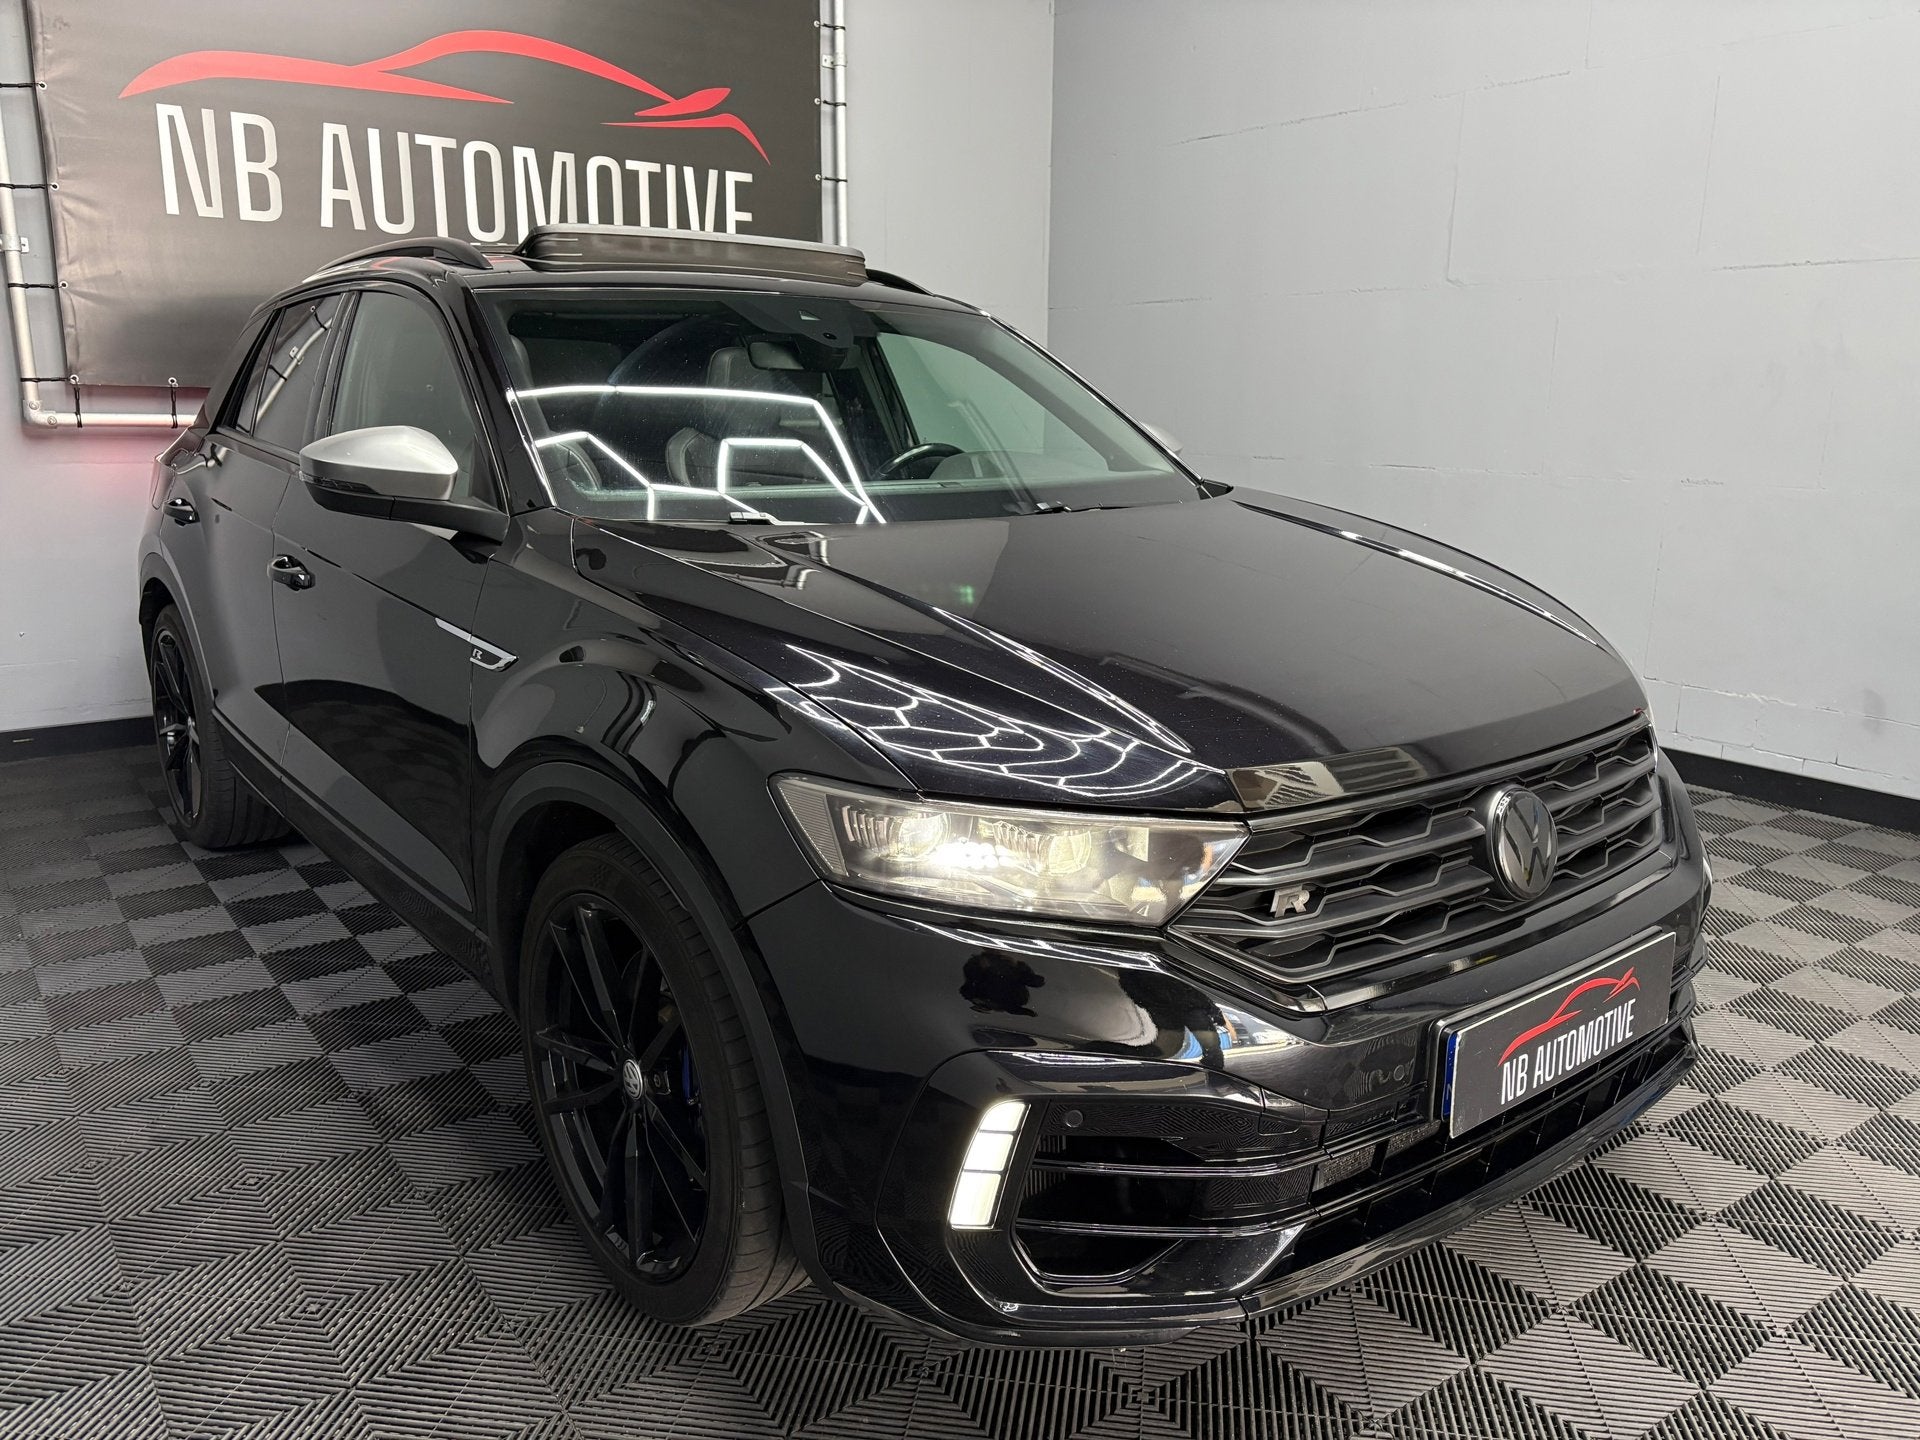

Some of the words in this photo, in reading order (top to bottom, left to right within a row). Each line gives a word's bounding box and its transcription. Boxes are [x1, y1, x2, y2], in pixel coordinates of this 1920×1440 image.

[156, 103, 283, 222] NB
[320, 122, 753, 244] AUTOMOTIVE
[1270, 886, 1310, 918] R
[1500, 1054, 1529, 1104] NB
[1532, 998, 1636, 1089] AUTOMOTIVE
